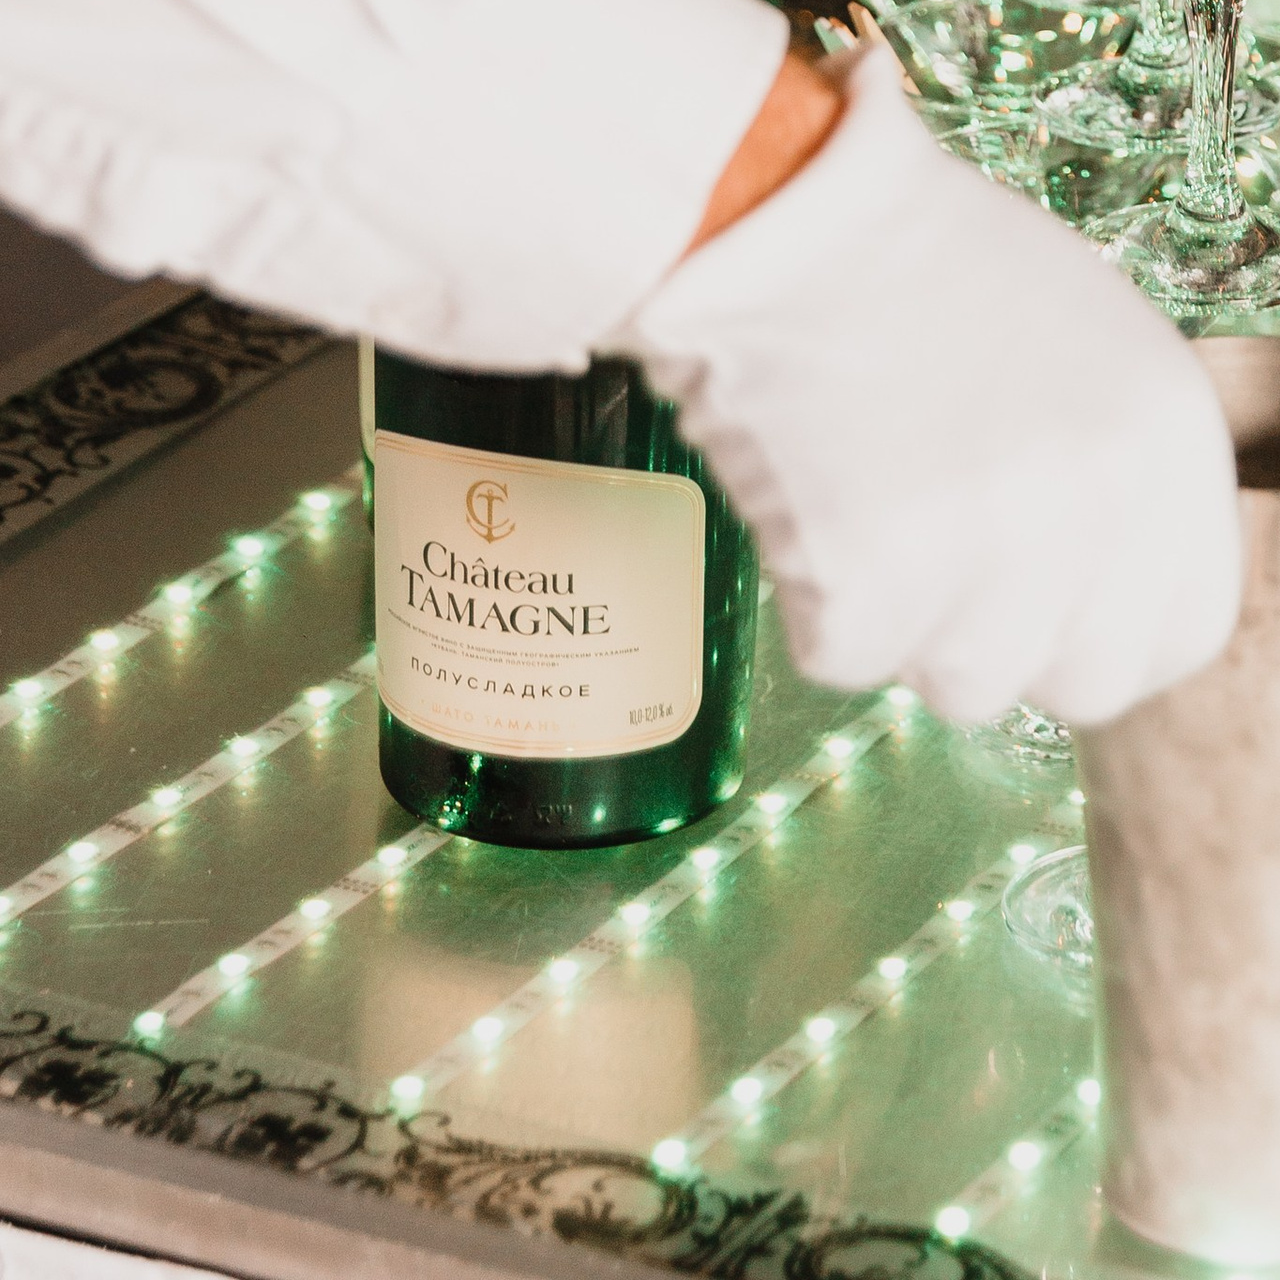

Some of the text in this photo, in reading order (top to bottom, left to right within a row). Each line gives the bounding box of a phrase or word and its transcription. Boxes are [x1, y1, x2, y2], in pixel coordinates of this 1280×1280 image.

[422, 540, 575, 595] Château
[401, 564, 612, 636] TAMAGNE
[440, 636, 458, 647] ВИНО
[594, 646, 640, 657] УКАЗАНИЕМ
[410, 656, 591, 700] ПОЛУСЛАДКОЕ
